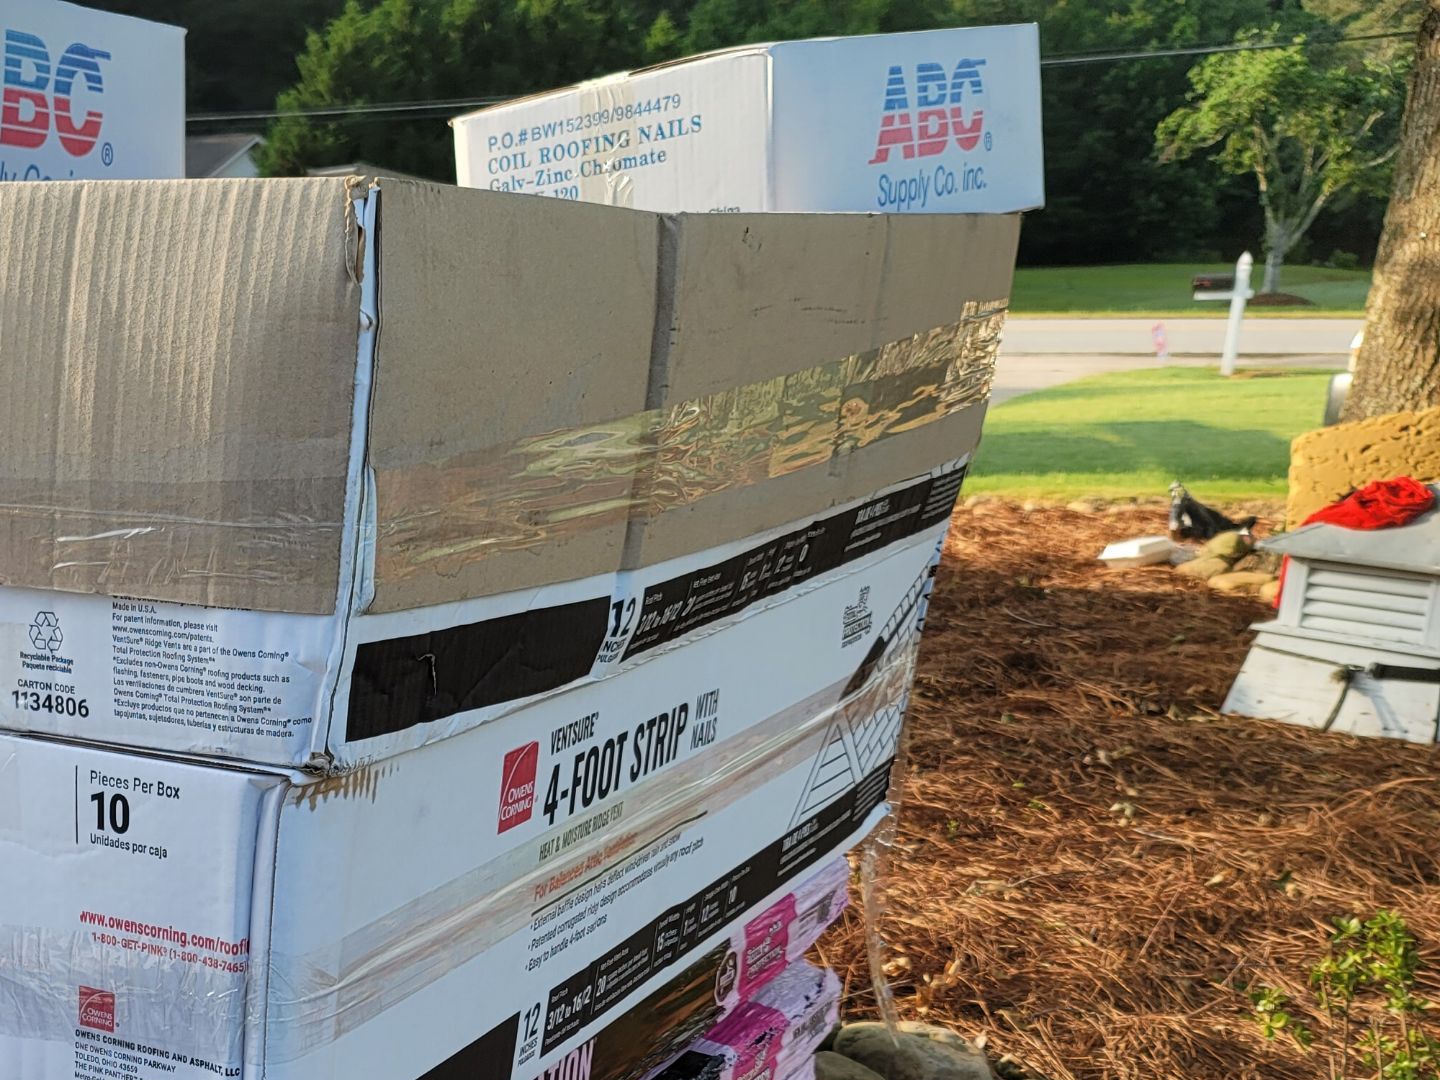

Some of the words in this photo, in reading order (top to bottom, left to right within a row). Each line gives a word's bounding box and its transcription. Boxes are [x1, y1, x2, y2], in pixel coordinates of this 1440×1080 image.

[868, 57, 987, 165] ABC
[488, 152, 531, 175] COIL
[539, 130, 630, 164] ROOFING
[638, 115, 702, 144] NAILS
[877, 172, 929, 210] Supply
[934, 167, 958, 196] Co.
[962, 165, 988, 190] inc.
[112, 602, 129, 612] Made
[112, 613, 122, 622] For
[182, 620, 204, 632] please
[17, 679, 52, 693] CARTON
[53, 683, 75, 695] CODE
[11, 689, 90, 719] 1134806
[694, 688, 720, 721] WITH
[689, 717, 718, 751] NAILS
[542, 731, 629, 826] 4-FOOT
[629, 702, 689, 783] STRIP
[90, 769, 129, 790] Pieces
[133, 777, 153, 794] Per
[157, 781, 180, 800] Box
[508, 780, 534, 803] OWENS
[90, 790, 130, 835] 10
[501, 796, 532, 822] CORNING
[90, 832, 130, 851] Unidades
[132, 841, 147, 855] por
[148, 845, 168, 860] caja
[81, 1012, 113, 1028] CORNING
[86, 1006, 114, 1020] OWENS
[523, 1001, 541, 1042] 12
[74, 1041, 88, 1053] ONE
[89, 1045, 112, 1058] OWENS
[113, 1050, 142, 1065] CORNING
[143, 1057, 176, 1073] PARKWAY
[74, 1052, 100, 1067] TOLEDO,
[101, 1058, 117, 1069] OHIO
[75, 1029, 101, 1043] OWENS
[102, 1035, 135, 1052] CORNING
[136, 1043, 169, 1060] ROOFING
[170, 1051, 187, 1064] AND
[188, 1055, 223, 1075] ASPHALT,
[224, 1063, 240, 1077] LLC
[518, 1036, 538, 1058] INCHES
[74, 1061, 87, 1072] THE
[88, 1064, 103, 1076] PINK
